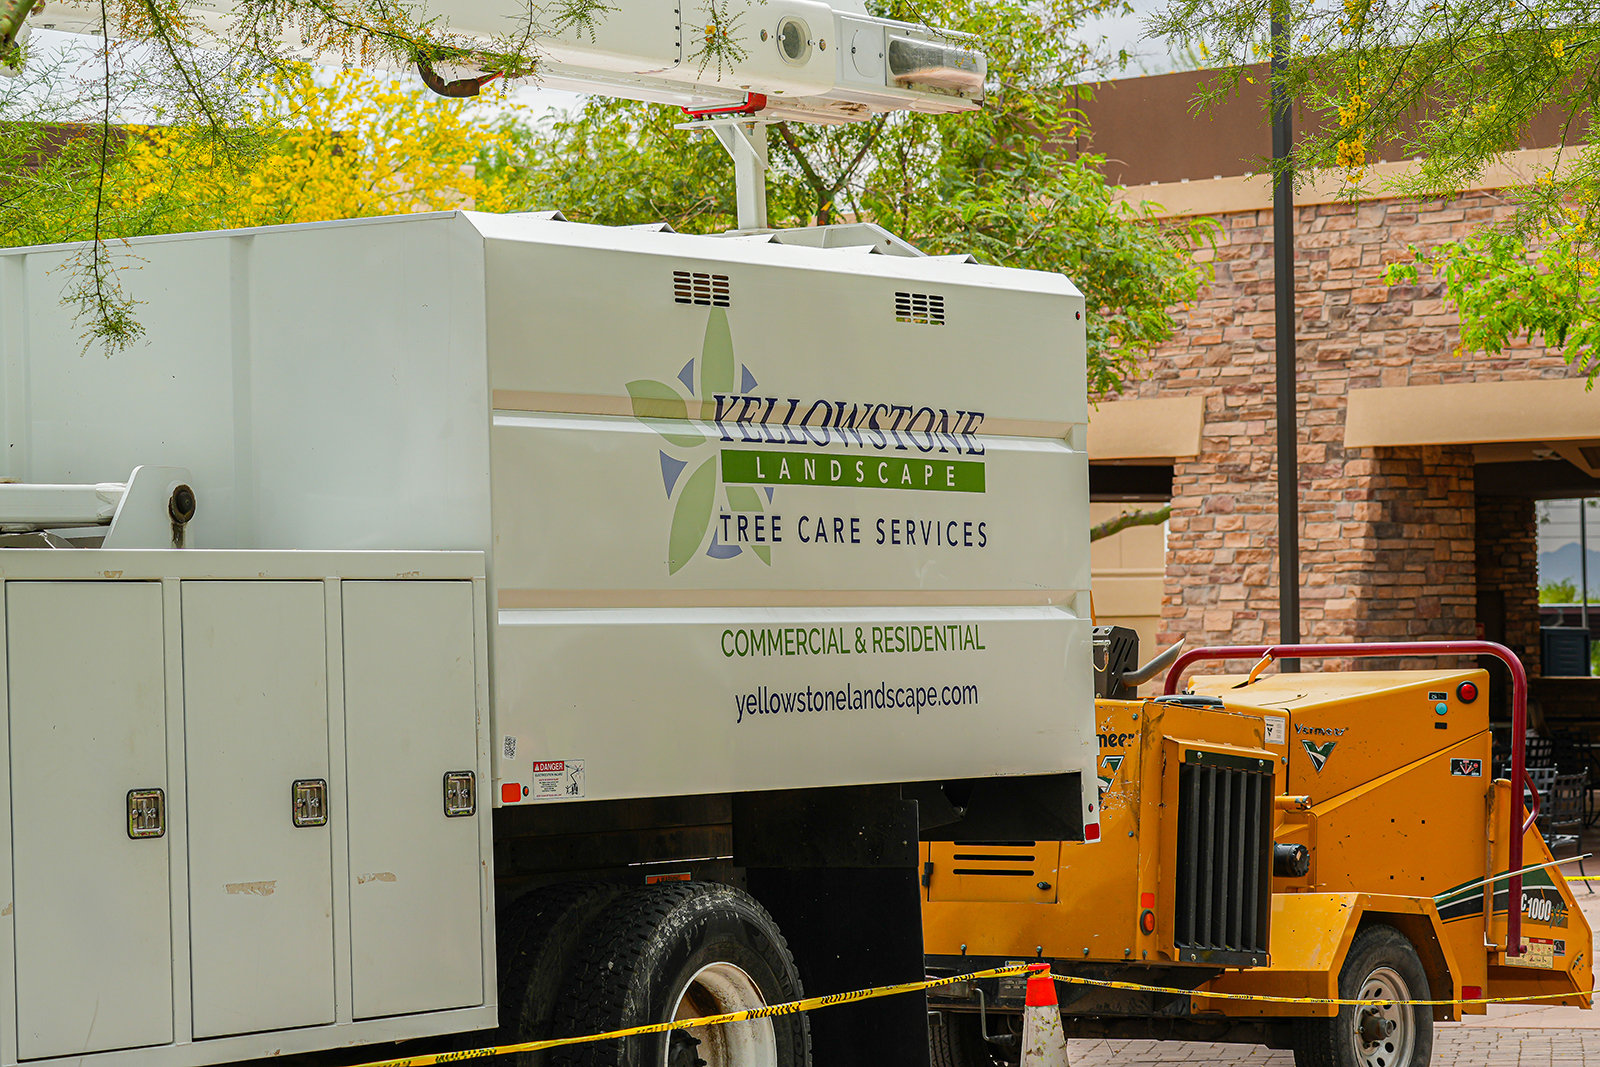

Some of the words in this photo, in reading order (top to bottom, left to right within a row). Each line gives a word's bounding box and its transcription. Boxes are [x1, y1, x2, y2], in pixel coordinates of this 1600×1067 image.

[713, 394, 986, 456] YELLOWSTONE
[756, 456, 956, 487] LANDSCAPE
[720, 515, 783, 542] TREE
[798, 516, 861, 544] CARE
[876, 518, 987, 548] SERVICES
[721, 626, 850, 657] COMMERCIAL
[854, 626, 867, 654] &
[872, 624, 986, 653] RESIDENTIAL
[735, 681, 979, 723] yellowstonelandscape.com
[1294, 723, 1345, 736] Vermeer
[540, 762, 563, 771] DANGER
[1521, 893, 1552, 922] C1000
